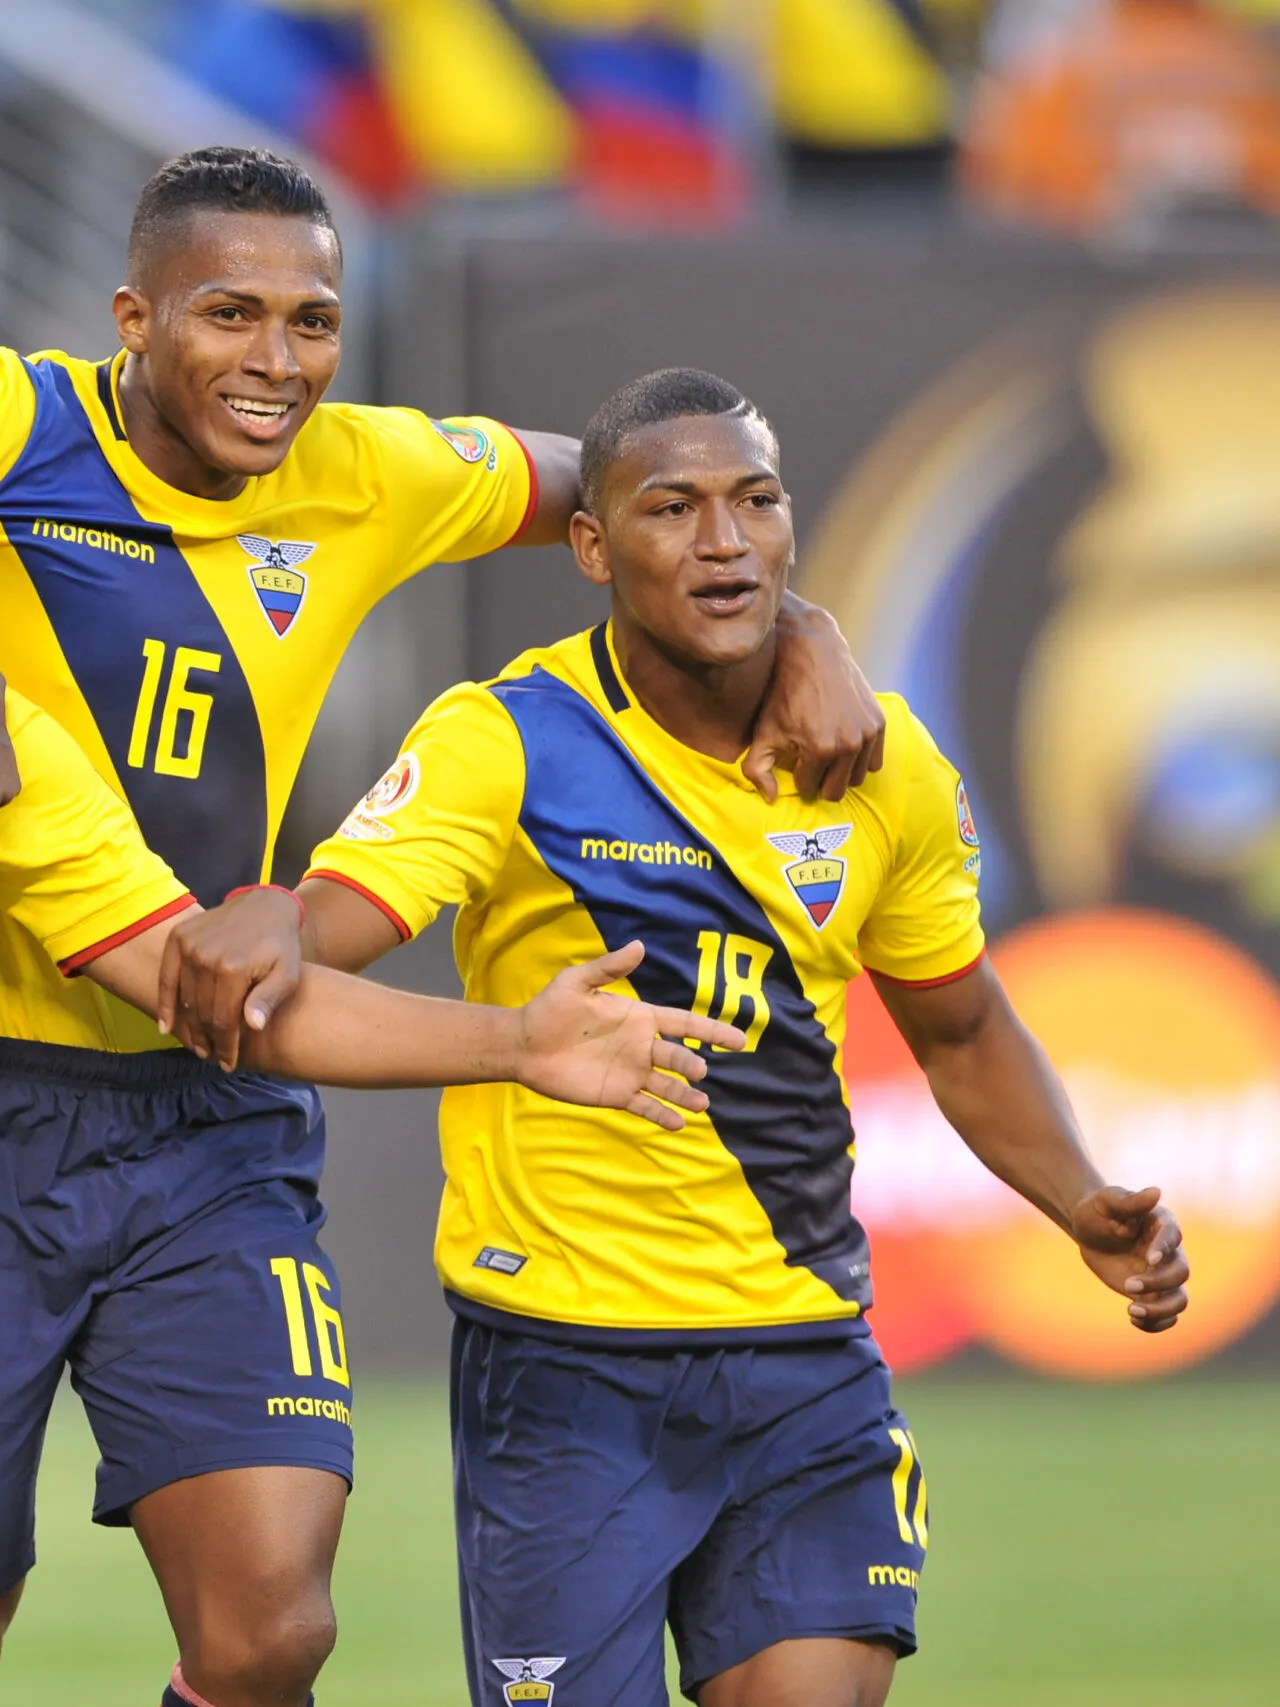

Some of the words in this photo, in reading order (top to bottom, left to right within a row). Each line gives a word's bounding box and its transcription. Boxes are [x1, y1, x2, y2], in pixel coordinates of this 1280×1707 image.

[32, 518, 155, 564] marathon
[127, 638, 222, 779] 16
[581, 838, 712, 871] marathon
[683, 930, 774, 1053] 18
[270, 1257, 350, 1389] 16
[267, 1396, 353, 1428] marath
